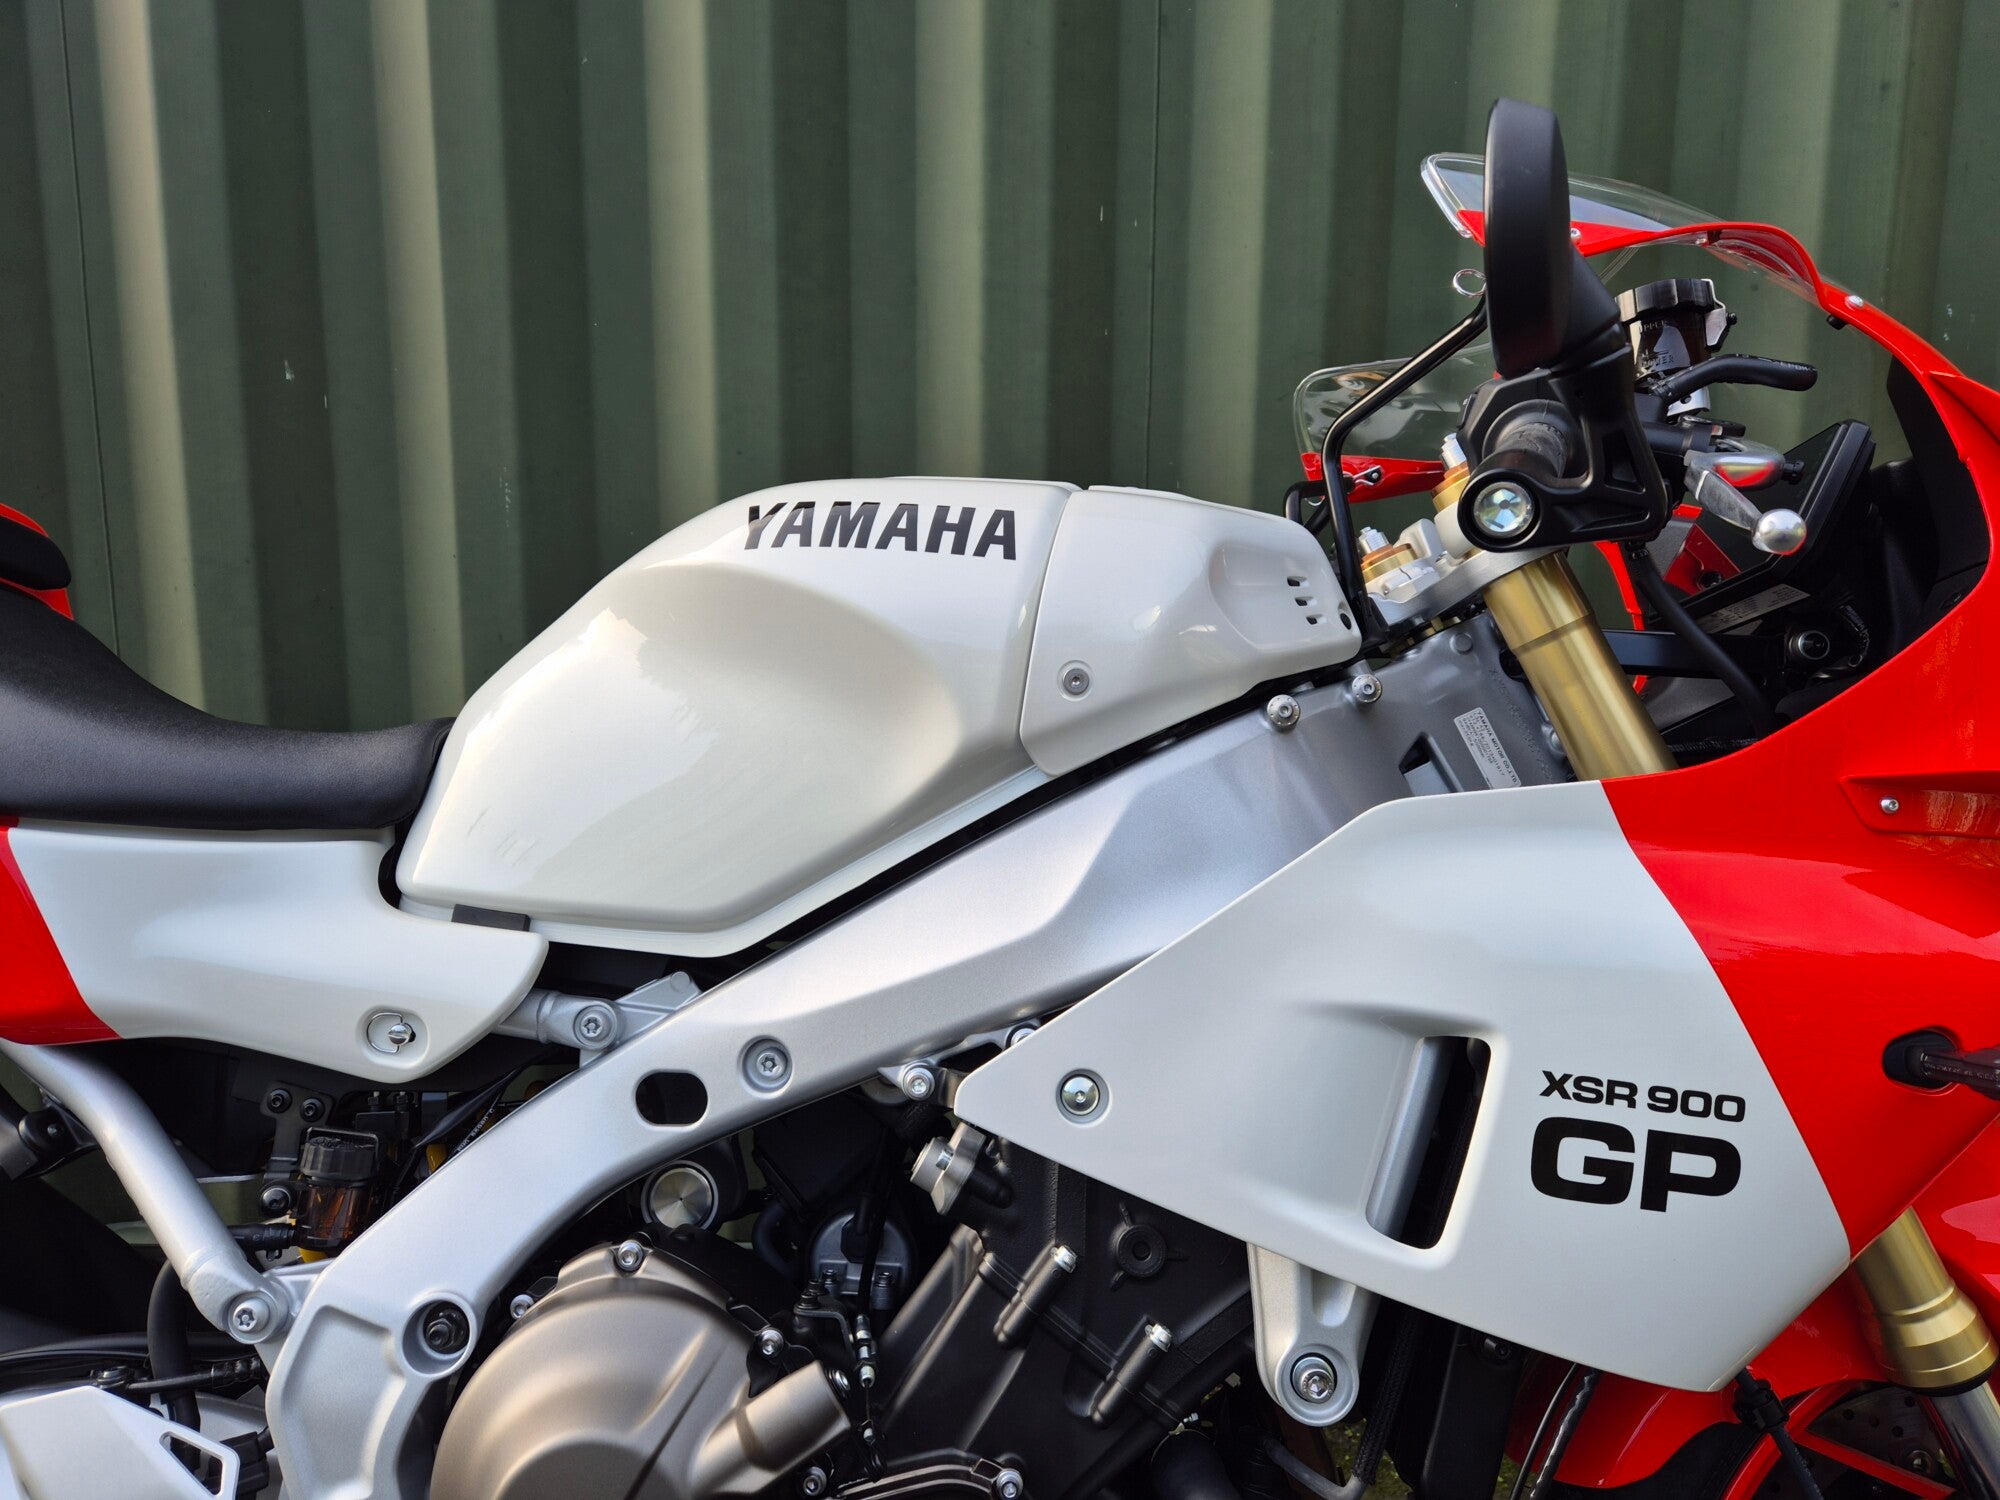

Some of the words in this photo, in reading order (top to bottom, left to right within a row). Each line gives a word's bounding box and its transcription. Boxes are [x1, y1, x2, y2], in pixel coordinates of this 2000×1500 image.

[744, 501, 1016, 560] YAMAHA
[1477, 711, 1493, 737] YAMAHA
[1491, 737, 1505, 760] MOTOR
[1539, 1070, 1638, 1109] XSR
[1646, 1085, 1746, 1123] 900
[1530, 1116, 1741, 1213] GP
